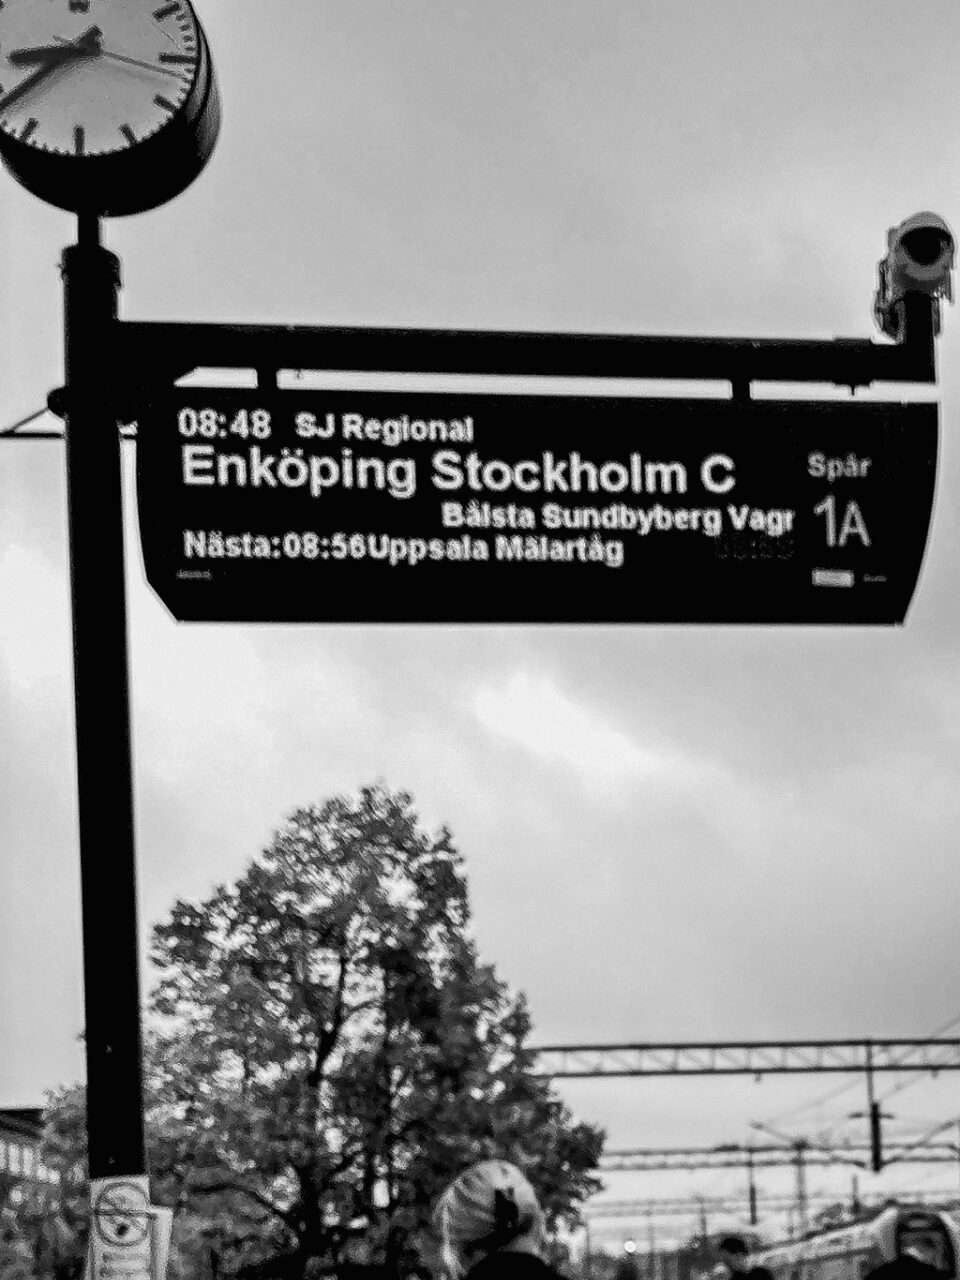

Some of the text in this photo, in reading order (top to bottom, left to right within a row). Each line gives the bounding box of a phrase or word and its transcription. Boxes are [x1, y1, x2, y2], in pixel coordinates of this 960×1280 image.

[178, 407, 474, 447] 08:48 SJ Regional
[181, 443, 736, 499] Enköping Stockholm C
[807, 452, 872, 482] Spår
[441, 499, 536, 529] Bålsta
[541, 502, 723, 537] Sundbyberg
[813, 495, 871, 547] 1A
[495, 533, 625, 568] Mälartåg
